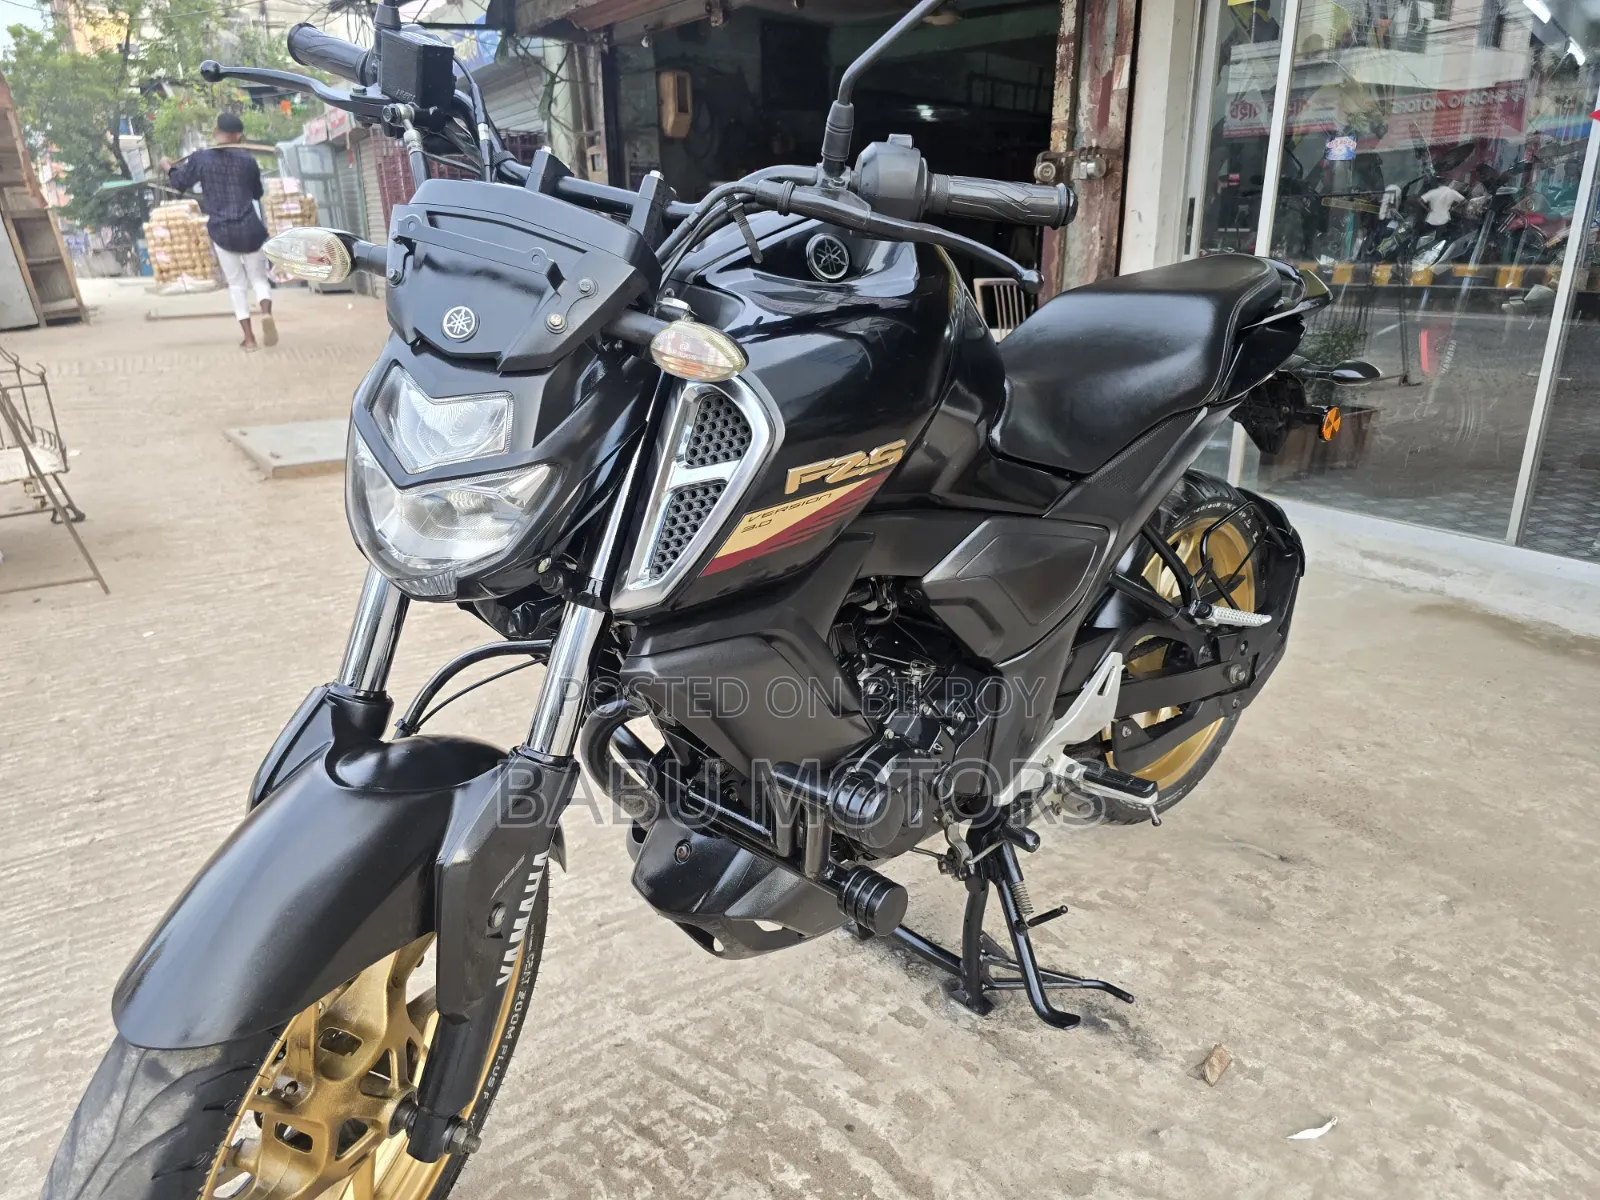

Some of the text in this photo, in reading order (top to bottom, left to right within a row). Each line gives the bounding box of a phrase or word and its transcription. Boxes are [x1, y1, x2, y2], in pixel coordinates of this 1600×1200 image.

[740, 518, 773, 534] 3.0
[505, 990, 527, 1040] ZOOM
[487, 1044, 509, 1088] PLUS
